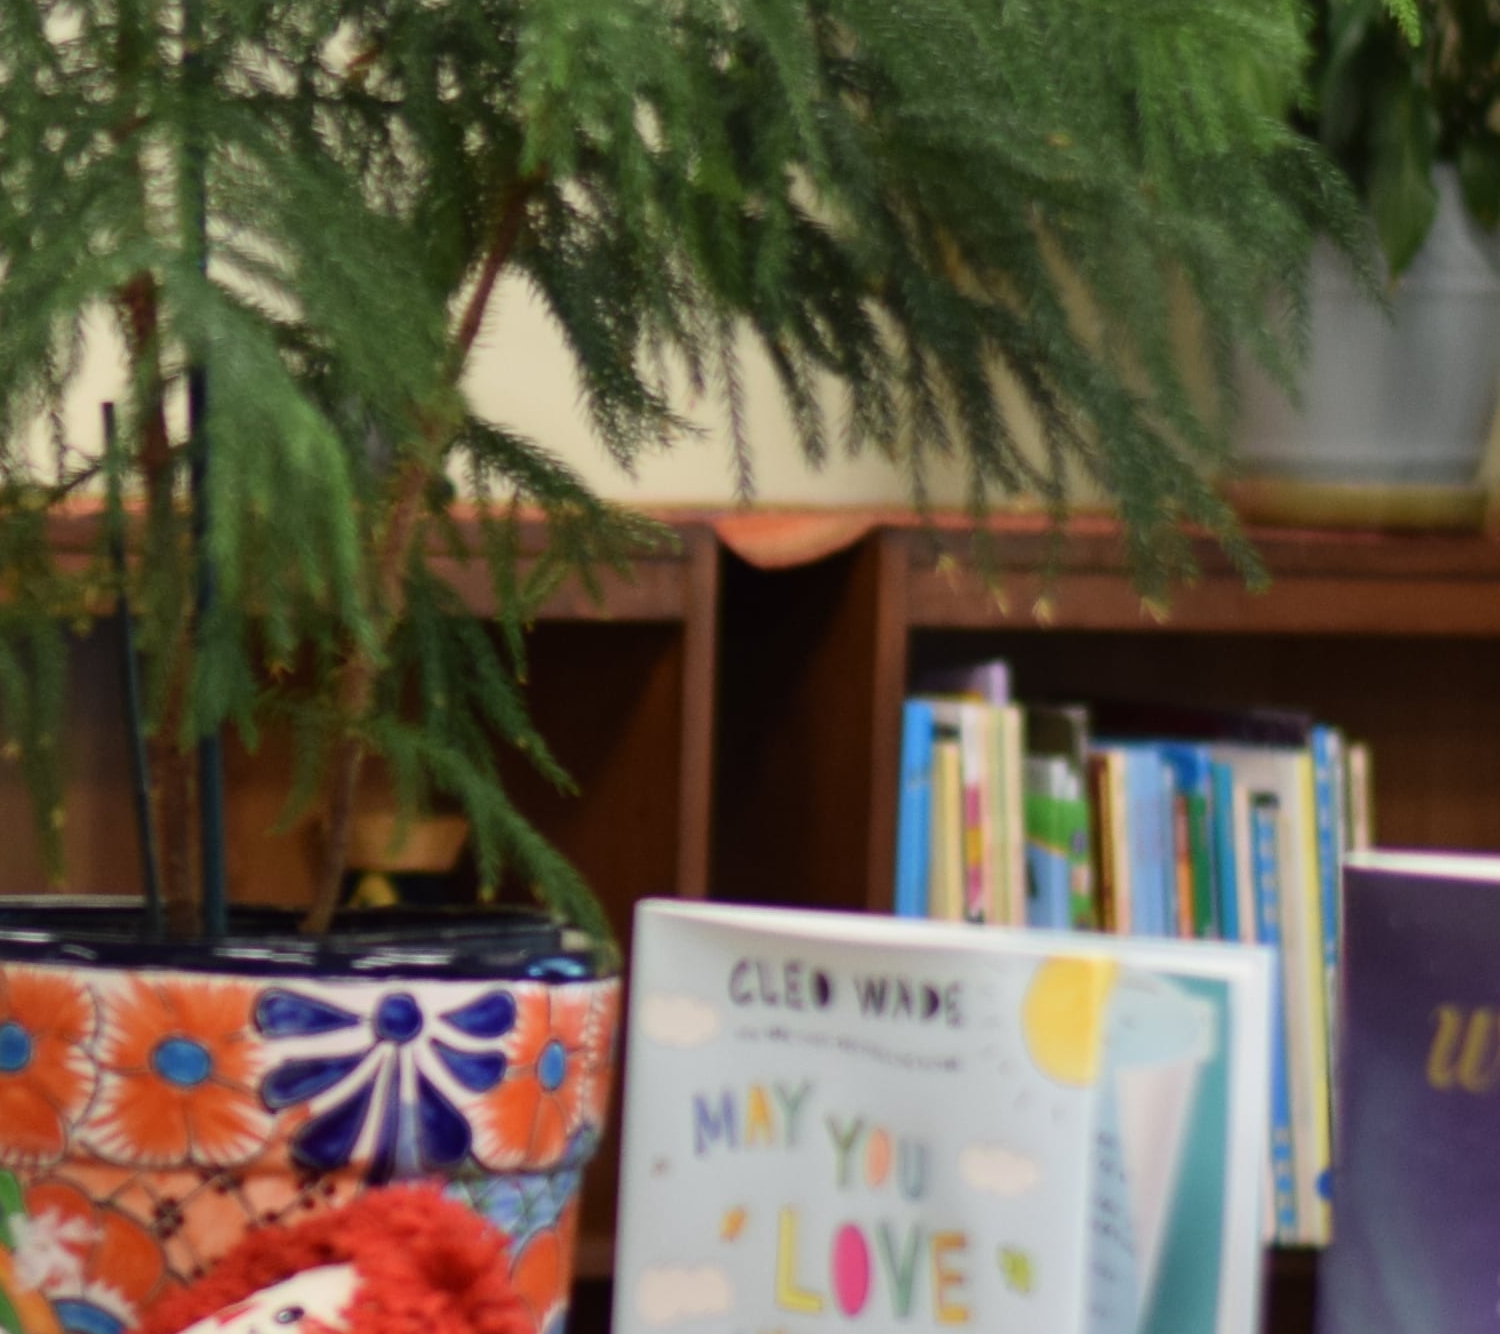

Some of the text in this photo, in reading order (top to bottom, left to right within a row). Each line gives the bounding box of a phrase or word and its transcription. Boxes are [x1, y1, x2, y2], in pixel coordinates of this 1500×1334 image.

[729, 956, 965, 1029] CLEO WADE
[692, 1079, 931, 1199] MAY YOU
[775, 1207, 972, 1326] LOVE
